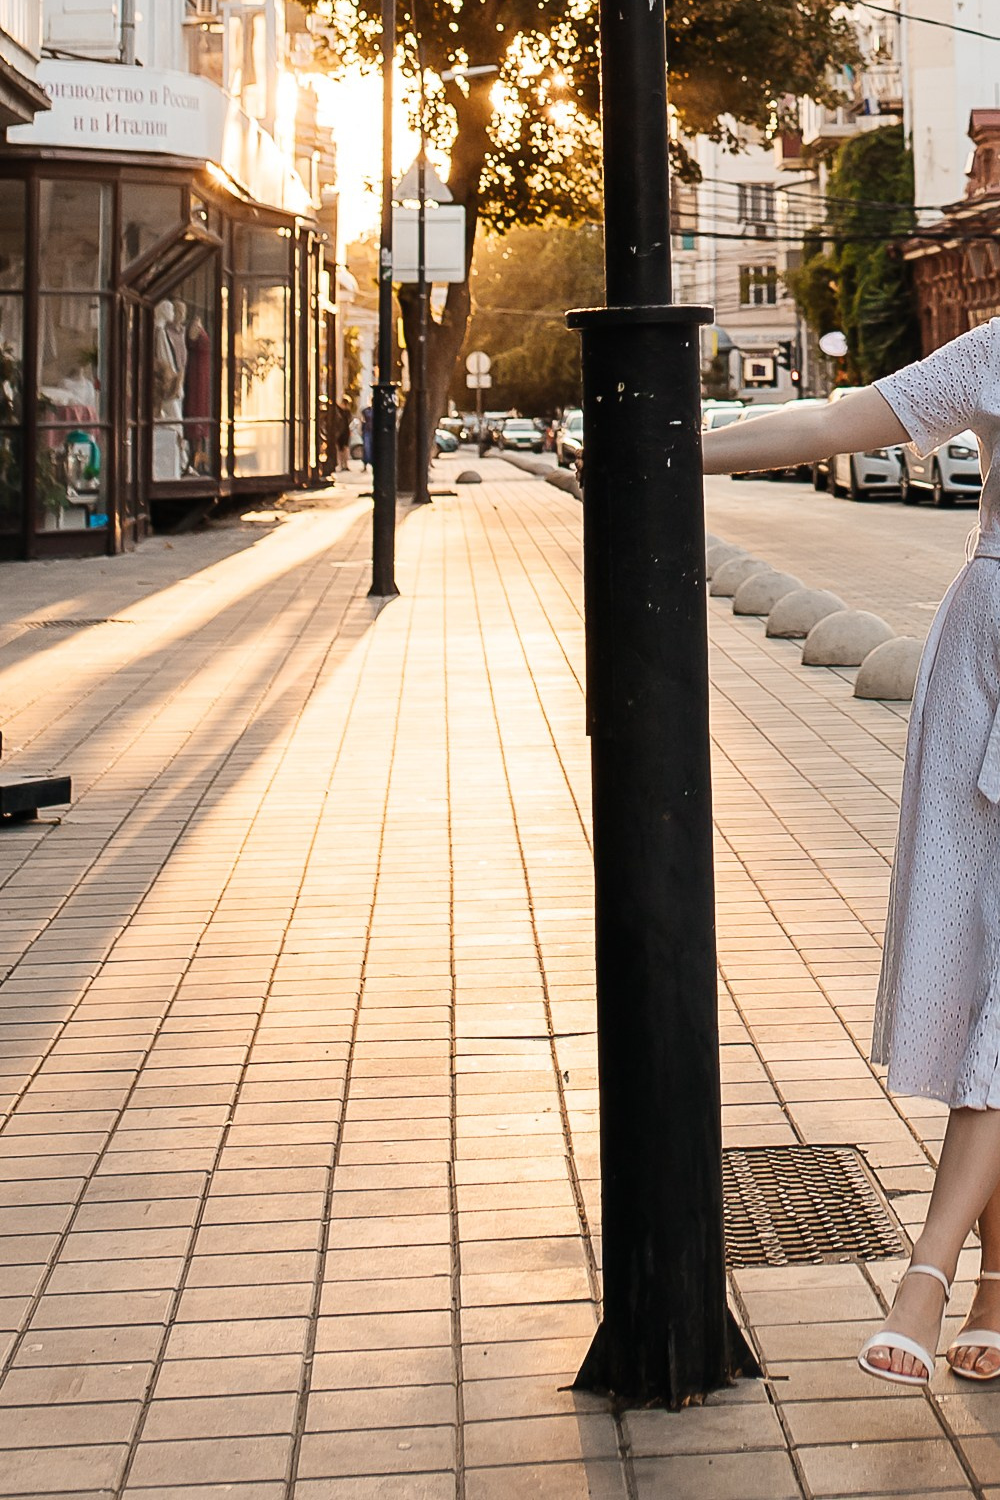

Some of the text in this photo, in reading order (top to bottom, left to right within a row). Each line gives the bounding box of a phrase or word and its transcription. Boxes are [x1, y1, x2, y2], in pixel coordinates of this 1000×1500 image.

[40, 81, 199, 110] оизводство в России
[90, 116, 99, 132] в
[106, 112, 168, 137] Италии
